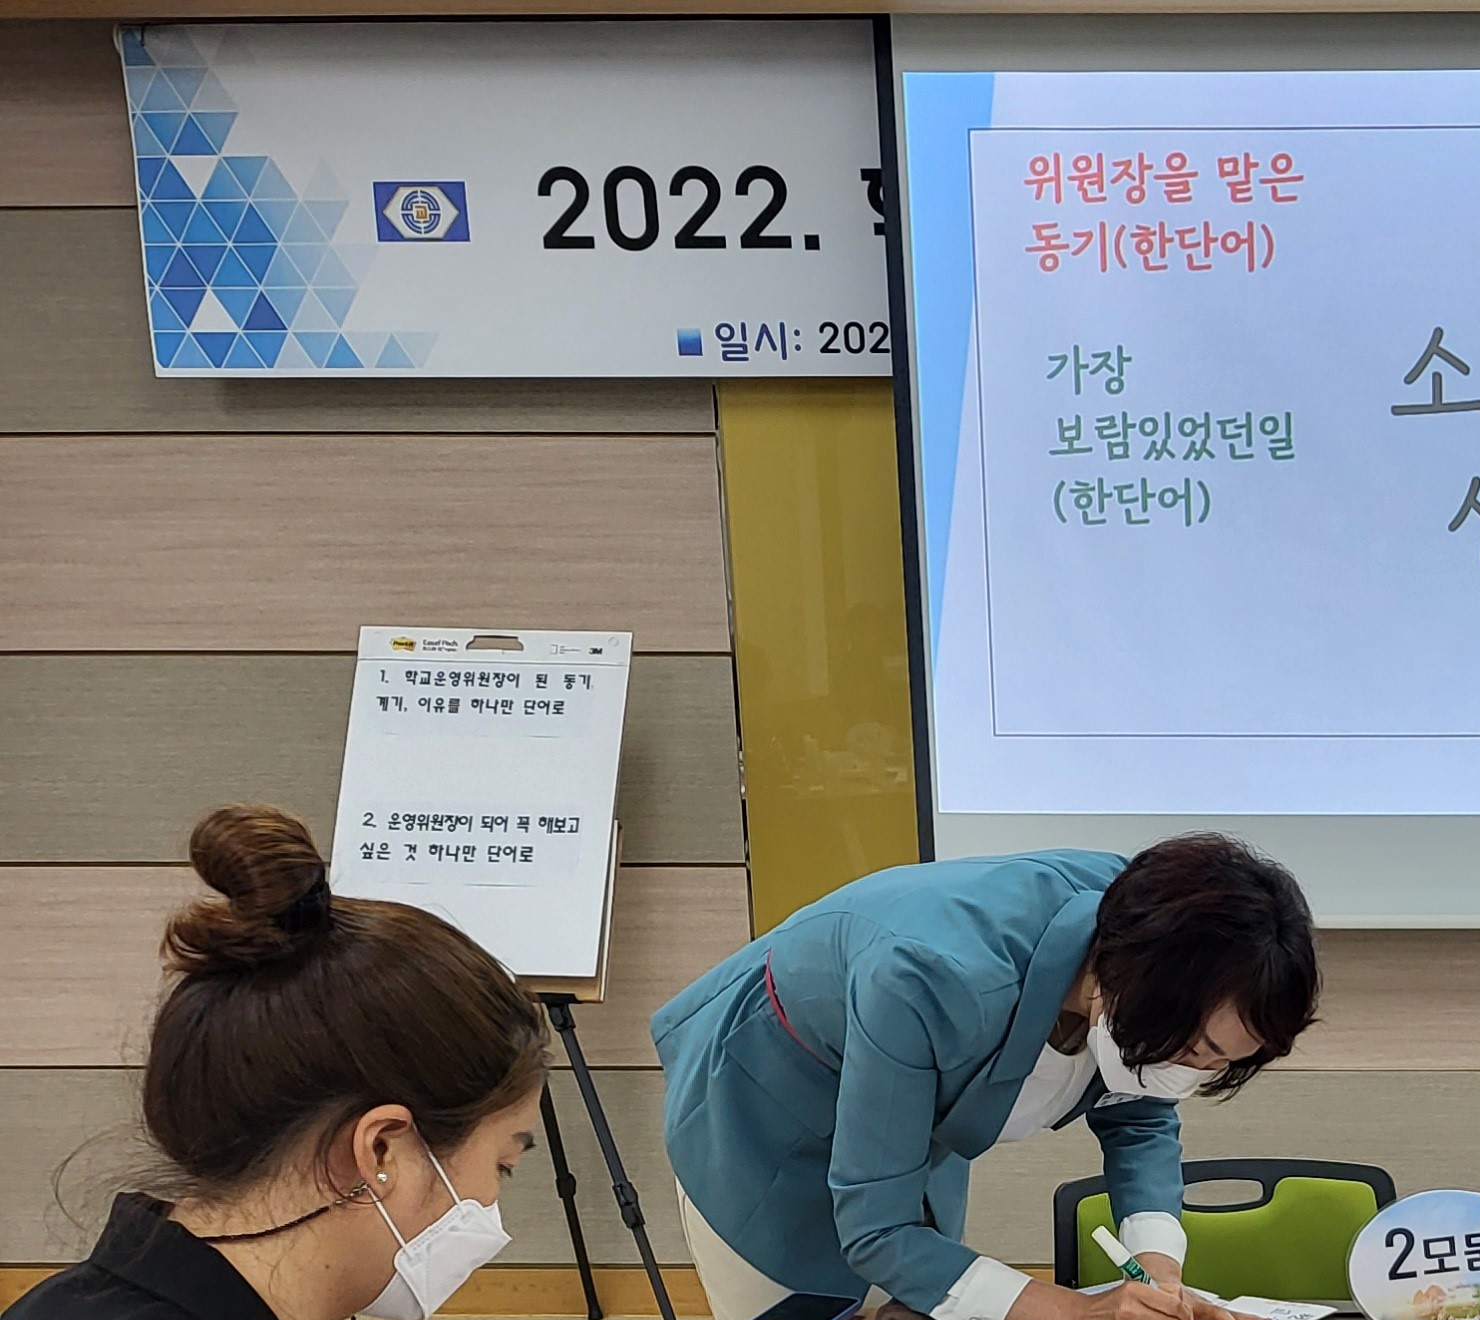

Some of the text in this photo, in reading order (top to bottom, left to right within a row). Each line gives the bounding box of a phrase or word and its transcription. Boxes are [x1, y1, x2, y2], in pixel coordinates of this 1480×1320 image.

[1024, 152, 1304, 205] 위원장을 맡은
[537, 165, 821, 252] 2022.
[1024, 220, 1275, 273] 동기(한단어)
[714, 321, 801, 361] 일시:
[1046, 344, 1132, 395] 가장
[1049, 411, 1295, 460] 보람있었던일
[1052, 476, 1212, 527] (한단어)
[380, 670, 389, 683] 1.
[405, 670, 520, 688] 학교운영위원장이
[535, 674, 548, 688] 된
[418, 697, 460, 714] 이유를
[471, 698, 514, 715] 하나만
[523, 700, 565, 716] 단어로
[387, 812, 473, 833] 운영위원장이
[480, 815, 509, 833] 되어
[538, 817, 580, 834] 해보고
[359, 842, 534, 863] 싶은 것 하나만 단어로
